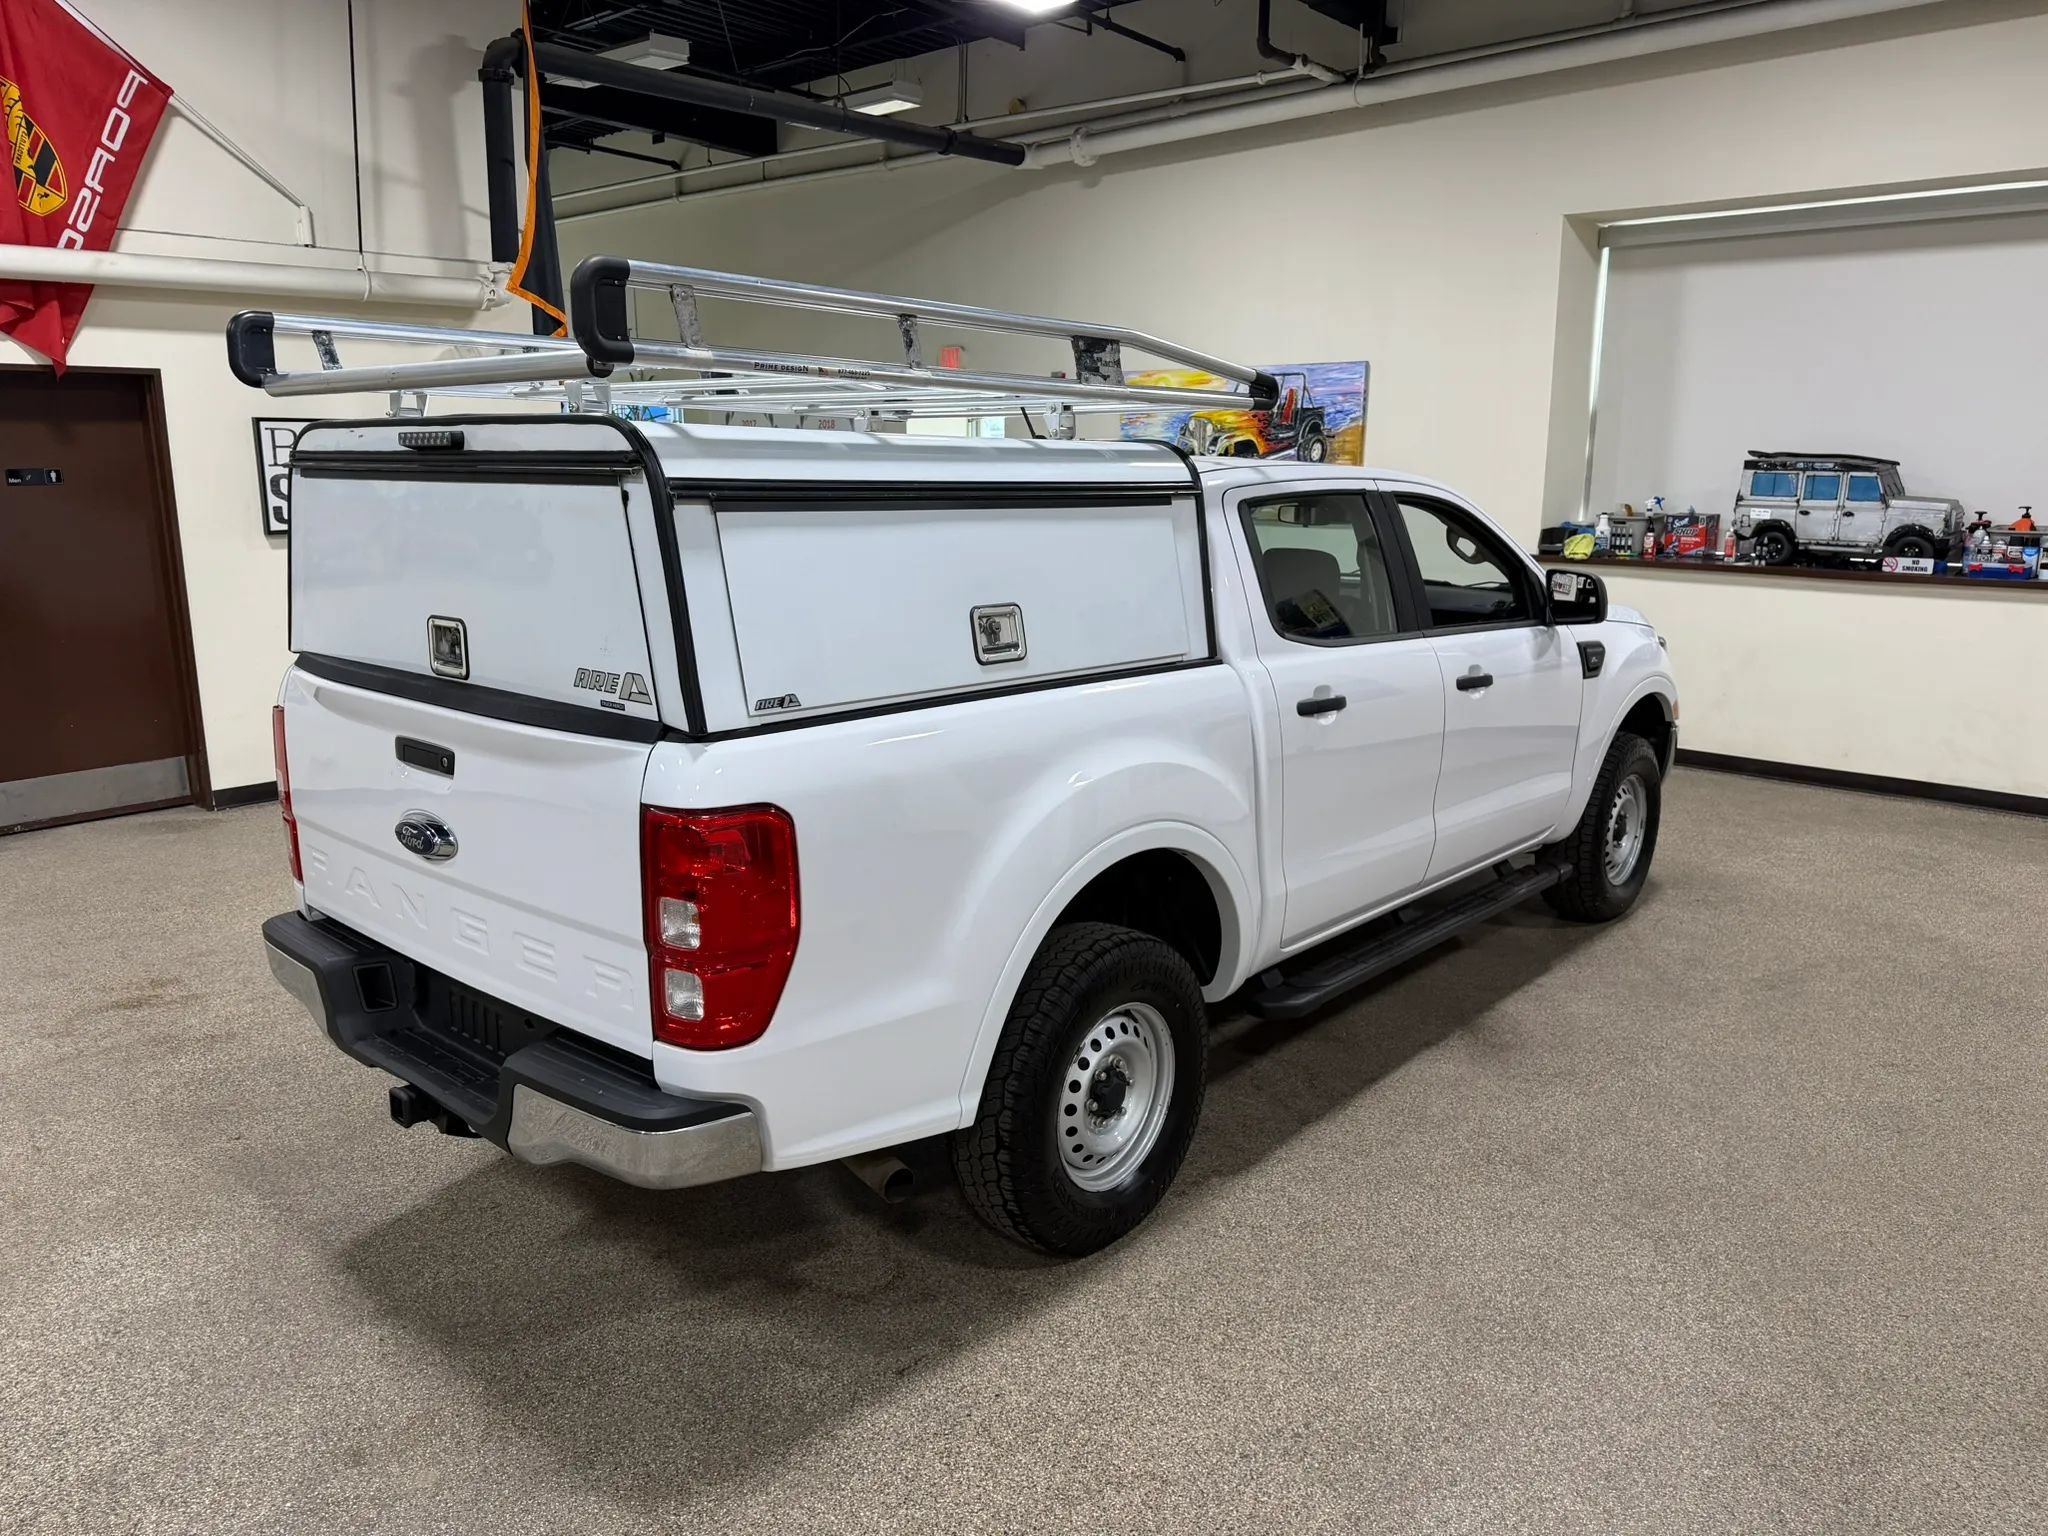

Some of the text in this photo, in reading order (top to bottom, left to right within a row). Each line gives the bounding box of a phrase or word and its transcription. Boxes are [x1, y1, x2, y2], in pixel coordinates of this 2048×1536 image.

[753, 361, 778, 371] PRIME
[780, 364, 809, 374] DESIGN
[818, 418, 836, 430] 2018
[1901, 565, 1928, 573] SMOKING
[401, 826, 424, 850] Ford
[305, 846, 636, 1011] RANGER
